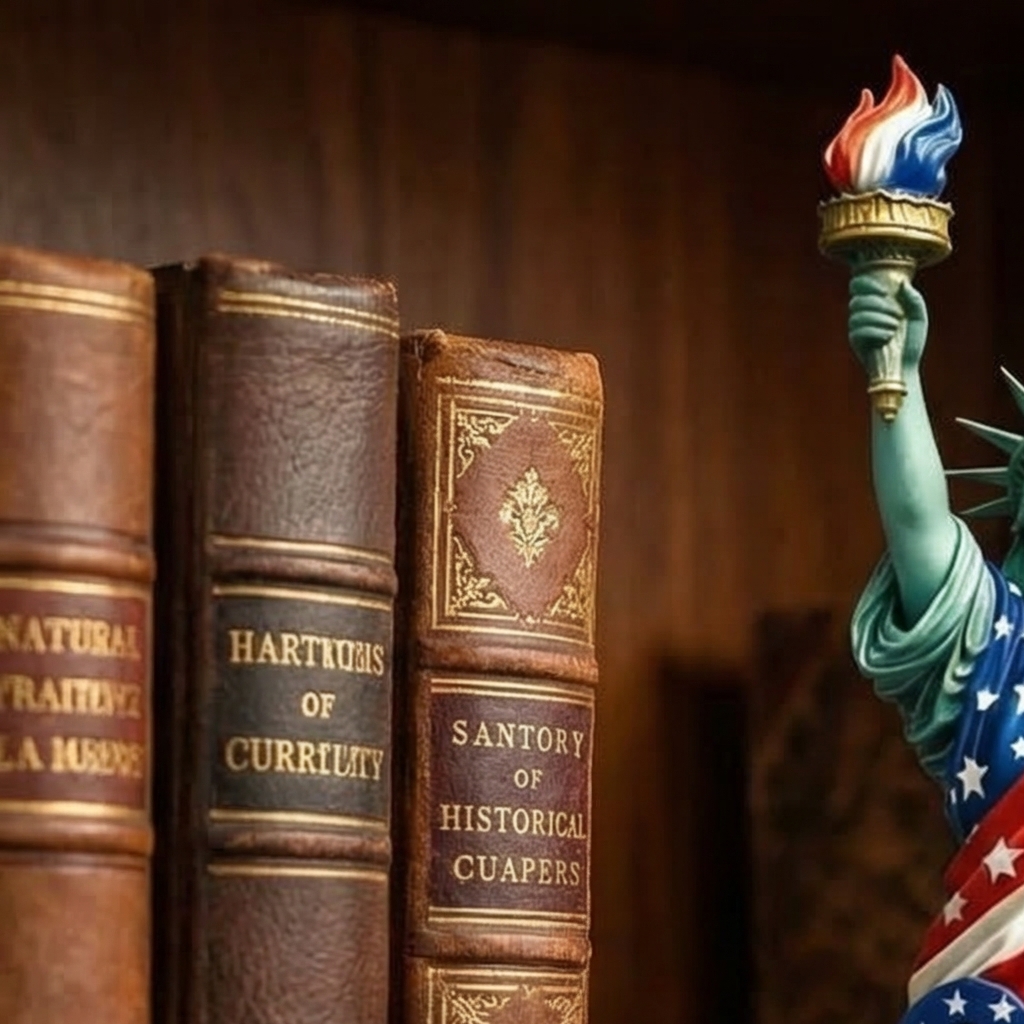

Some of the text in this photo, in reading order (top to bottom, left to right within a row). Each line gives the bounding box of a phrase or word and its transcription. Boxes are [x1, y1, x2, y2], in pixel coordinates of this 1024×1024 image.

[302, 691, 336, 718] OF
[452, 720, 583, 758] SANTORY
[514, 769, 543, 790] OF
[440, 804, 586, 839] HISTORICAL
[453, 855, 581, 886] CUAPERS
